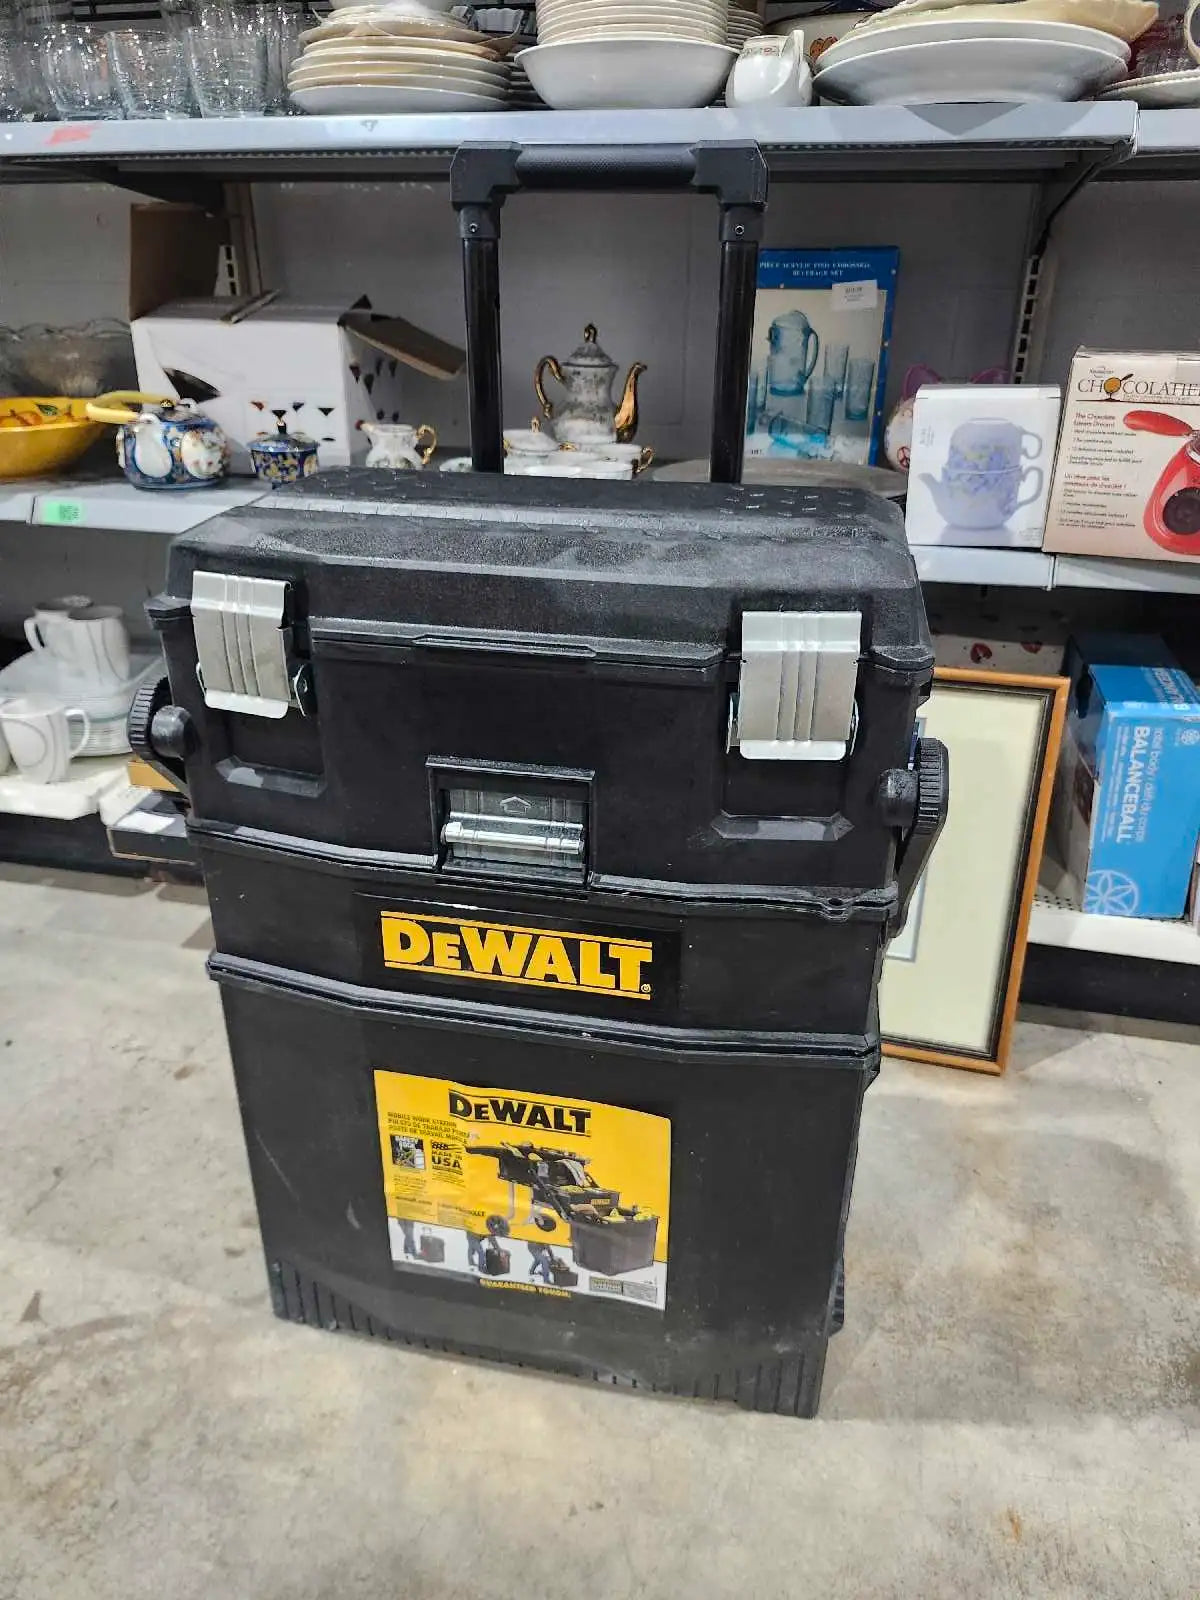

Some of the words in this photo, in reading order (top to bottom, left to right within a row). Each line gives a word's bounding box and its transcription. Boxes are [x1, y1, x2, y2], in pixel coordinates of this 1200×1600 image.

[1078, 377, 1200, 397] CHOCOLATIE
[1115, 726, 1151, 844] BALANCEBALL
[380, 914, 653, 994] DEWALT
[448, 1091, 592, 1135] DEWALT
[431, 1155, 462, 1170] USA
